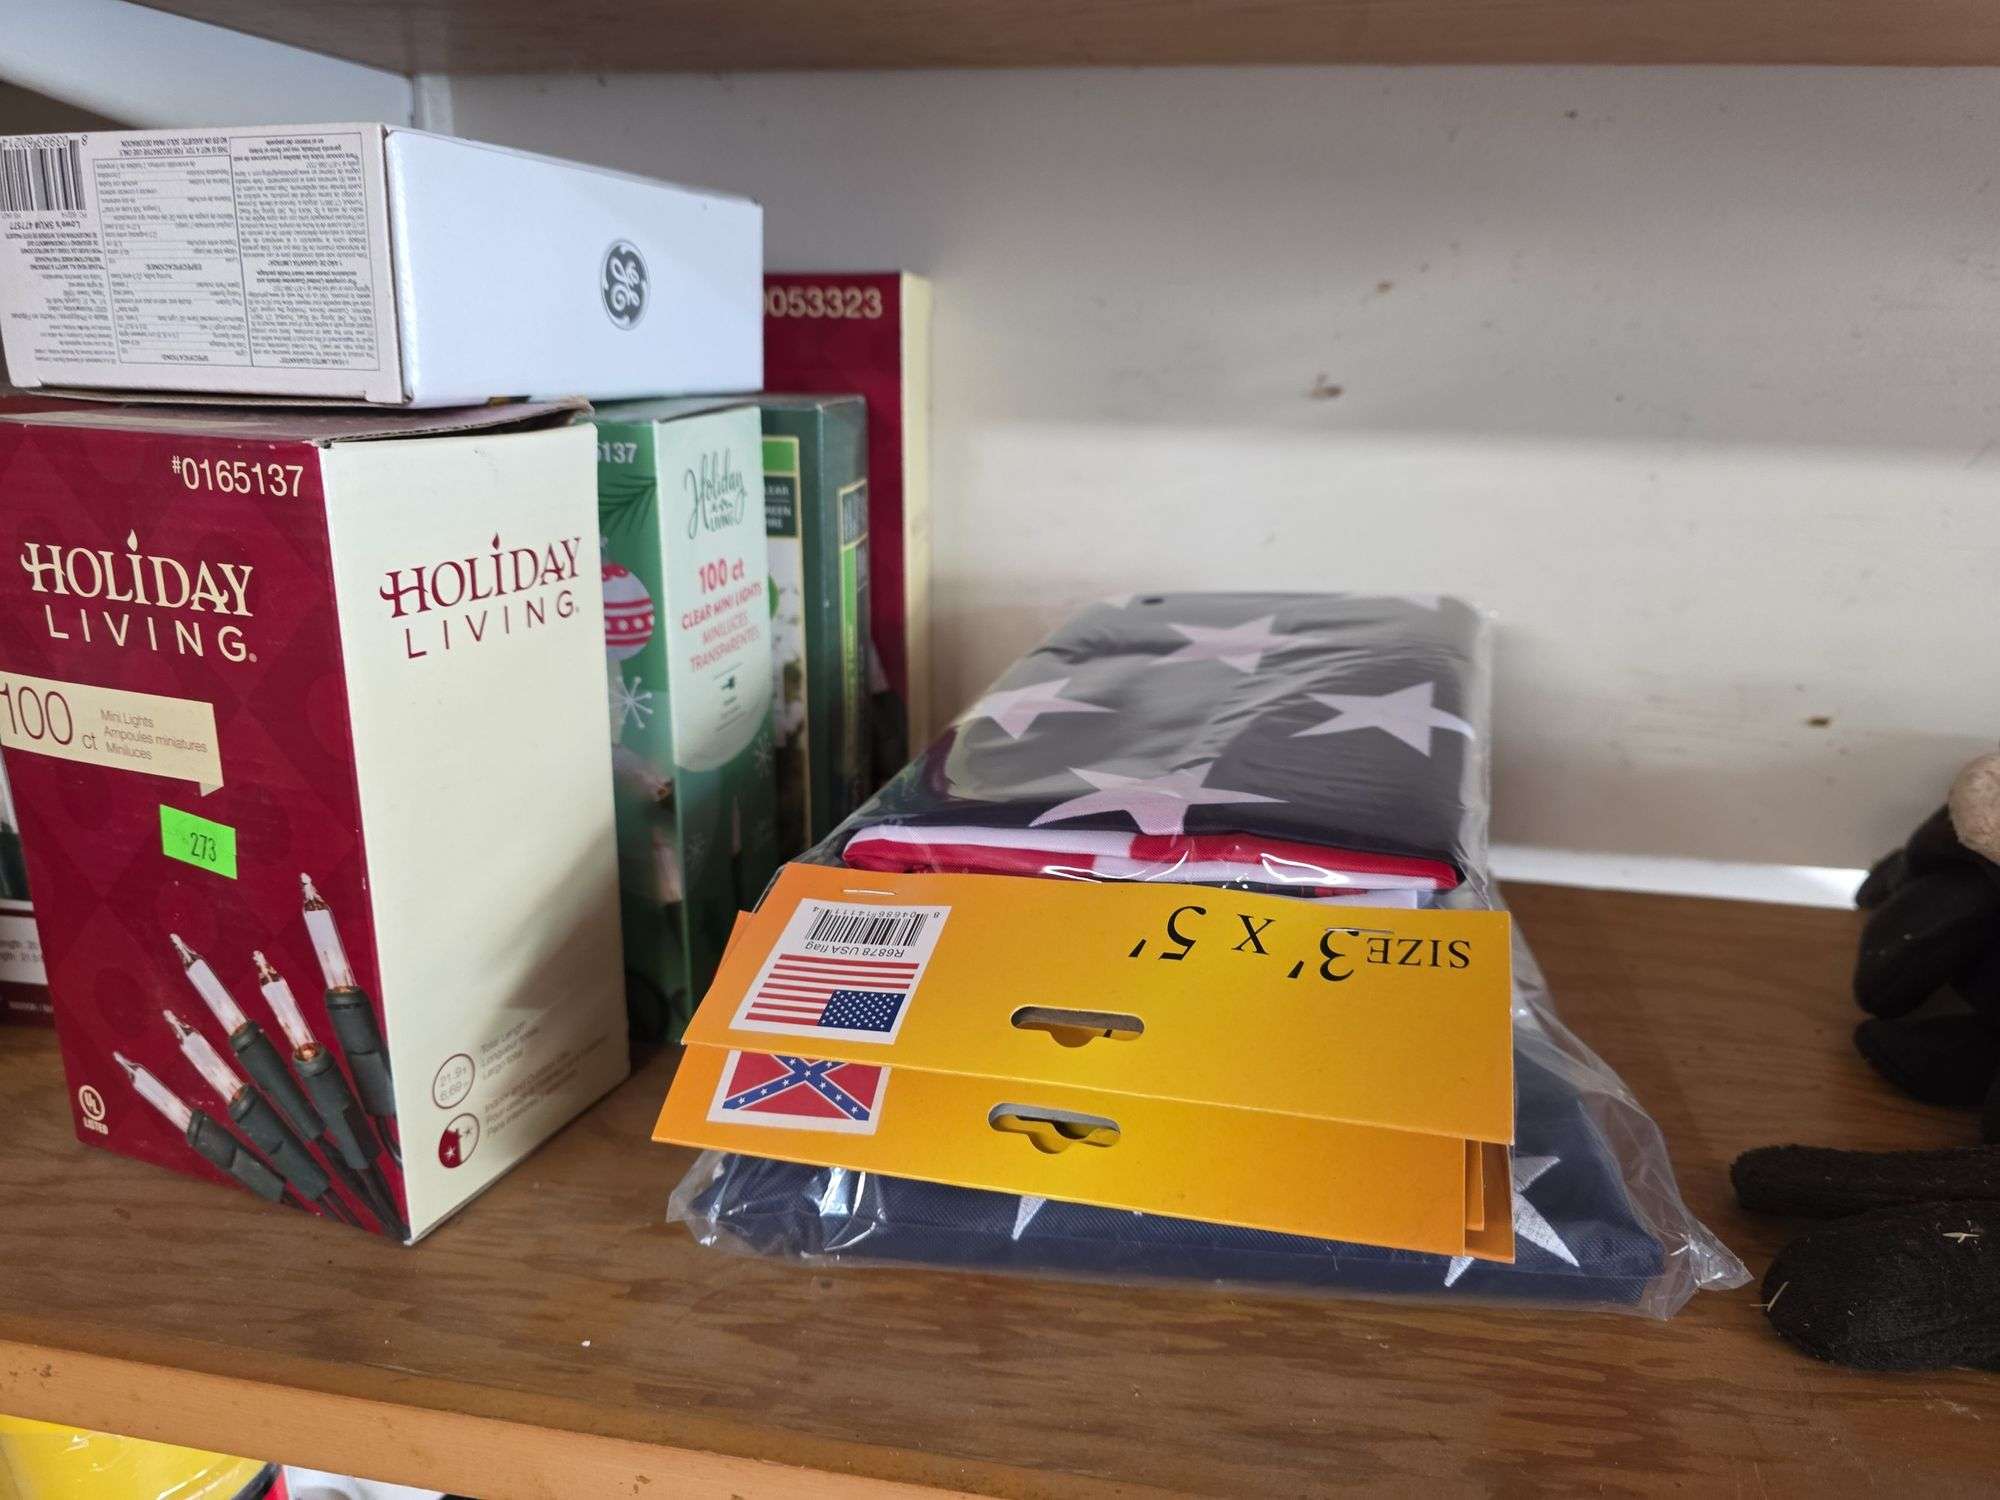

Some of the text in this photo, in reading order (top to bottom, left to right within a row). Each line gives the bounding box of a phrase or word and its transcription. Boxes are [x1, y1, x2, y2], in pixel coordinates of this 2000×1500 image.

[764, 285, 883, 319] 053323
[171, 455, 304, 498] #0165137
[20, 530, 255, 617] HOLIDAY
[379, 532, 583, 619] HOLIDAY
[0, 682, 99, 751] 100 ct
[100, 709, 154, 729] Mini Lights
[104, 725, 208, 753] Ampoules miniatures
[189, 831, 217, 863] 273
[805, 941, 905, 958] R6878 USA flag
[1128, 906, 1207, 961] 5'
[1366, 937, 1472, 970] SIZE
